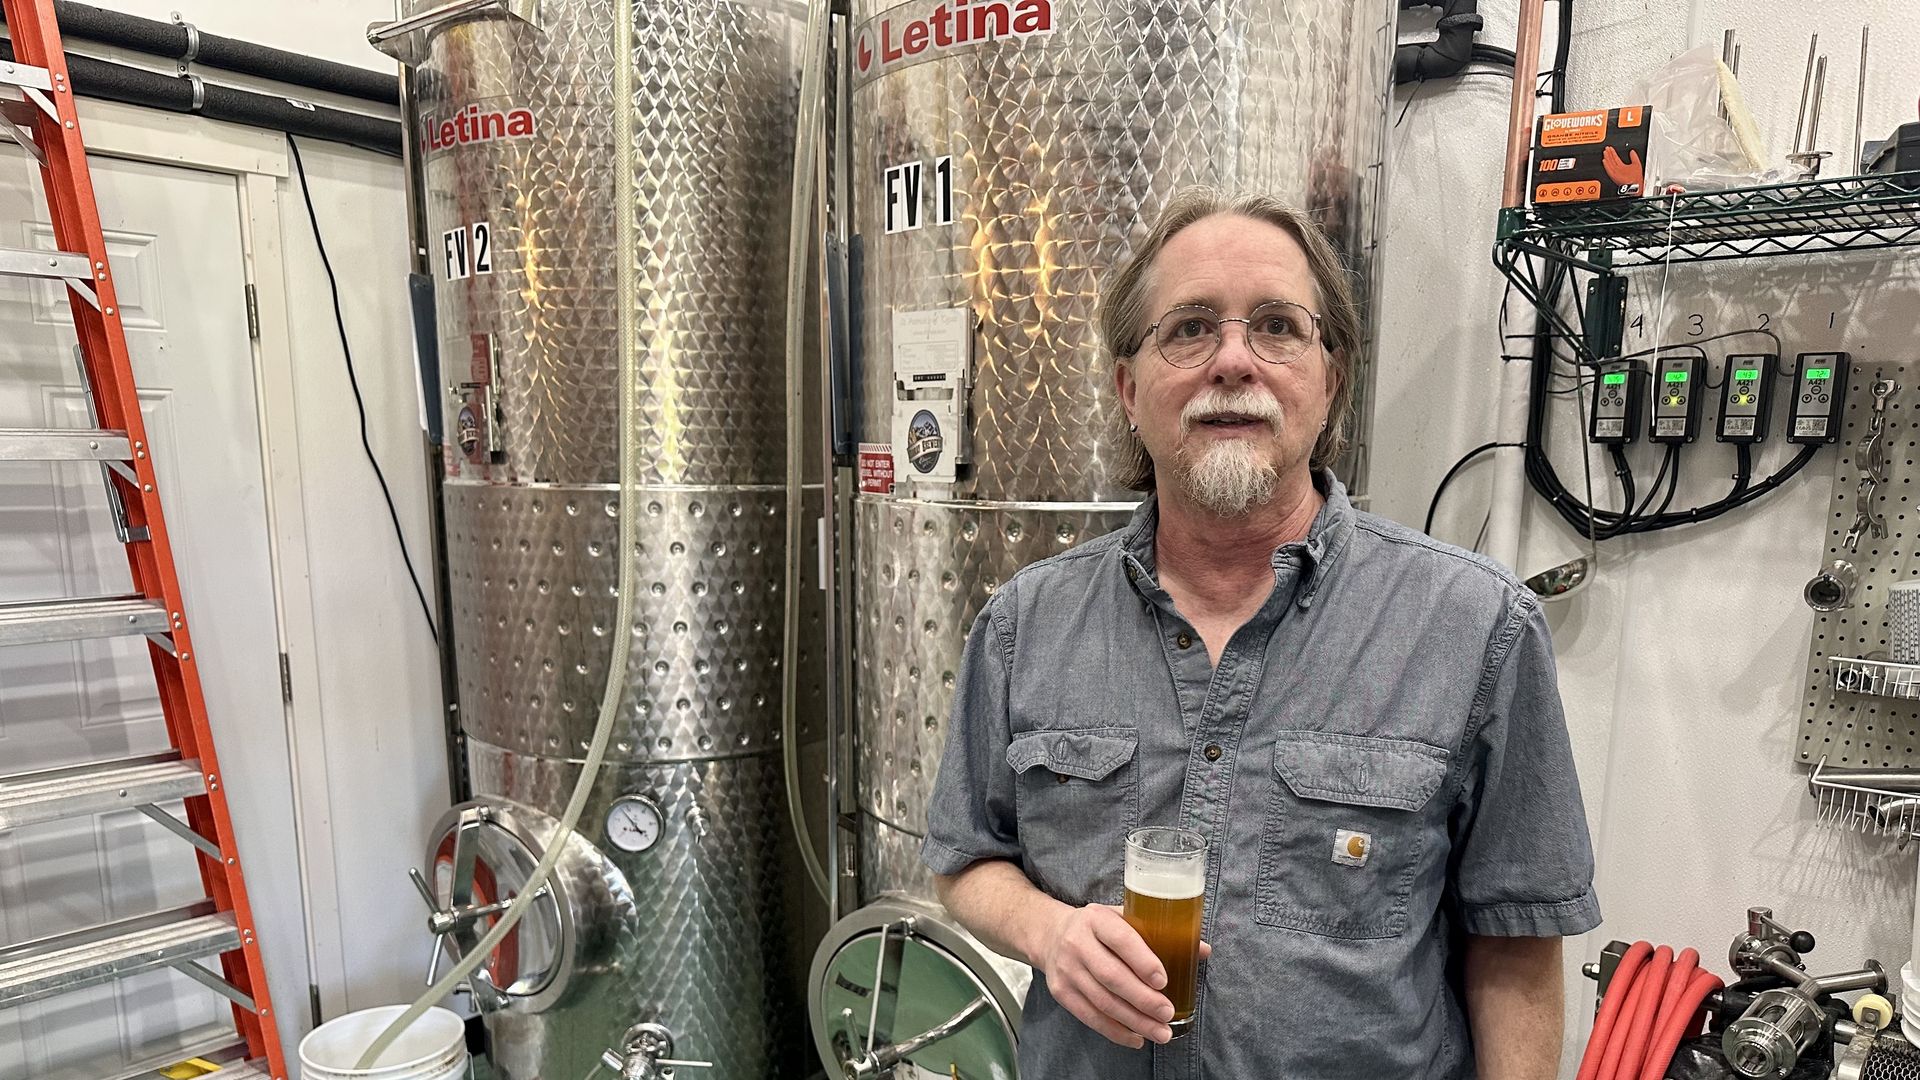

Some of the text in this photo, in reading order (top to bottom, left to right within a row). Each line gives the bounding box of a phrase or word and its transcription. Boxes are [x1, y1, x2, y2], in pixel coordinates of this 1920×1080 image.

[881, 0, 1051, 64] Letina
[1543, 114, 1603, 131] GLOVEWORKS
[1626, 111, 1634, 122] L
[428, 106, 533, 151] Letina
[1539, 159, 1558, 171] 100
[887, 157, 951, 232] FV 1
[444, 224, 490, 280] FV 2
[1630, 314, 1643, 338] 4
[1687, 314, 1704, 336] 3
[1756, 313, 1770, 333] 2
[1829, 312, 1835, 329] 1
[875, 459, 890, 468] ENTER
[873, 469, 893, 479] WITHOUT
